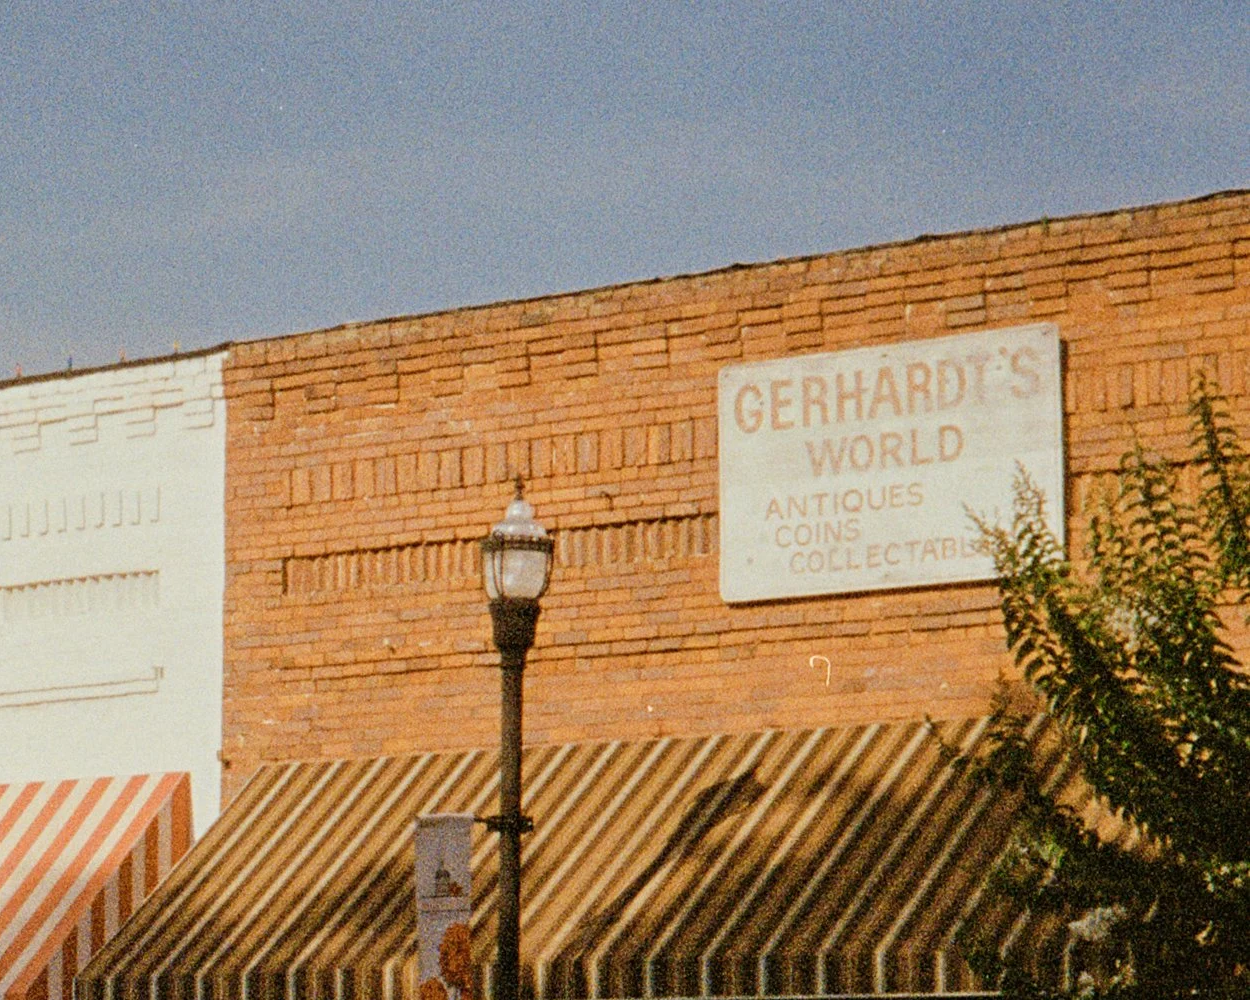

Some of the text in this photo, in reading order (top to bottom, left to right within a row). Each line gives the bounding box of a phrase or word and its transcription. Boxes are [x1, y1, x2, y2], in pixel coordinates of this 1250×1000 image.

[733, 345, 1040, 434] GERHARDT'S
[804, 423, 965, 478] WORLD
[764, 481, 925, 522] ANTIQUES
[774, 517, 862, 548] COINS
[788, 536, 992, 575] COLLECTABL
